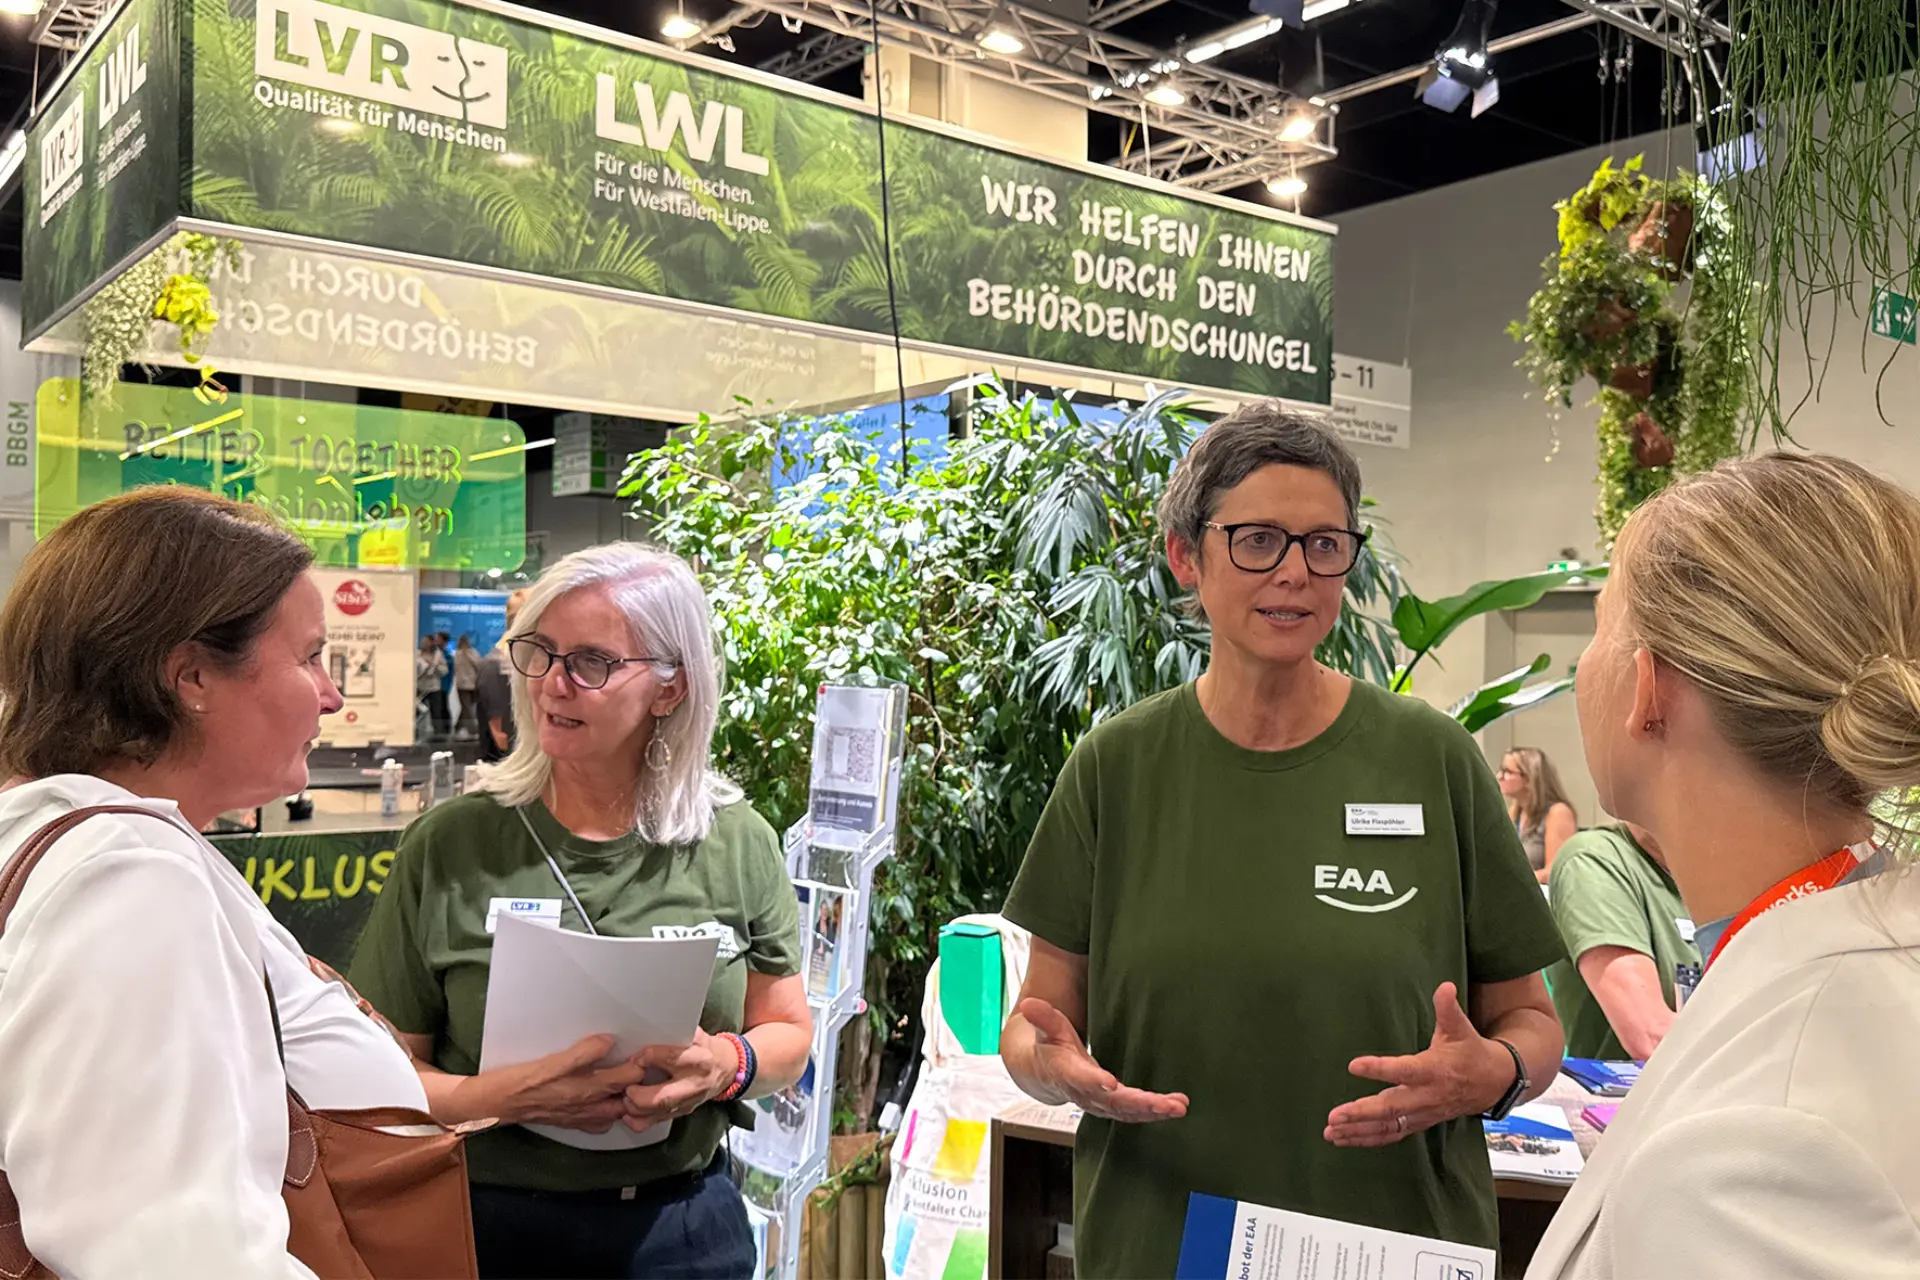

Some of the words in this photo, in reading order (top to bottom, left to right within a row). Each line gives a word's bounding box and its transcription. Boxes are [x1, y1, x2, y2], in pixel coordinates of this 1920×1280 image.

[100, 22, 147, 130] LWL
[274, 9, 411, 91] LVR
[254, 81, 353, 120] Qualität
[358, 102, 394, 129] für
[397, 111, 507, 153] Menschen
[596, 72, 769, 176] LWL
[44, 130, 67, 189] LVR
[594, 151, 626, 176] Für
[628, 160, 659, 184] die
[663, 167, 755, 206] Menschen.
[594, 178, 625, 203] Für
[981, 174, 1057, 227] WIR
[1079, 200, 1199, 258] HELFEN
[1217, 233, 1311, 282] IHNEN
[1072, 249, 1177, 302] DURCH
[1197, 275, 1256, 317] DEN
[967, 278, 1318, 374] BEHÖRDENDSCHUNGEL
[1357, 365, 1374, 390] 11
[6, 401, 30, 468] BBGM
[123, 419, 265, 468] BETTER
[290, 433, 462, 484] TOGETHER
[1315, 865, 1395, 895] EAA
[1242, 1241, 1254, 1260] der
[1245, 1217, 1257, 1239] EAA
